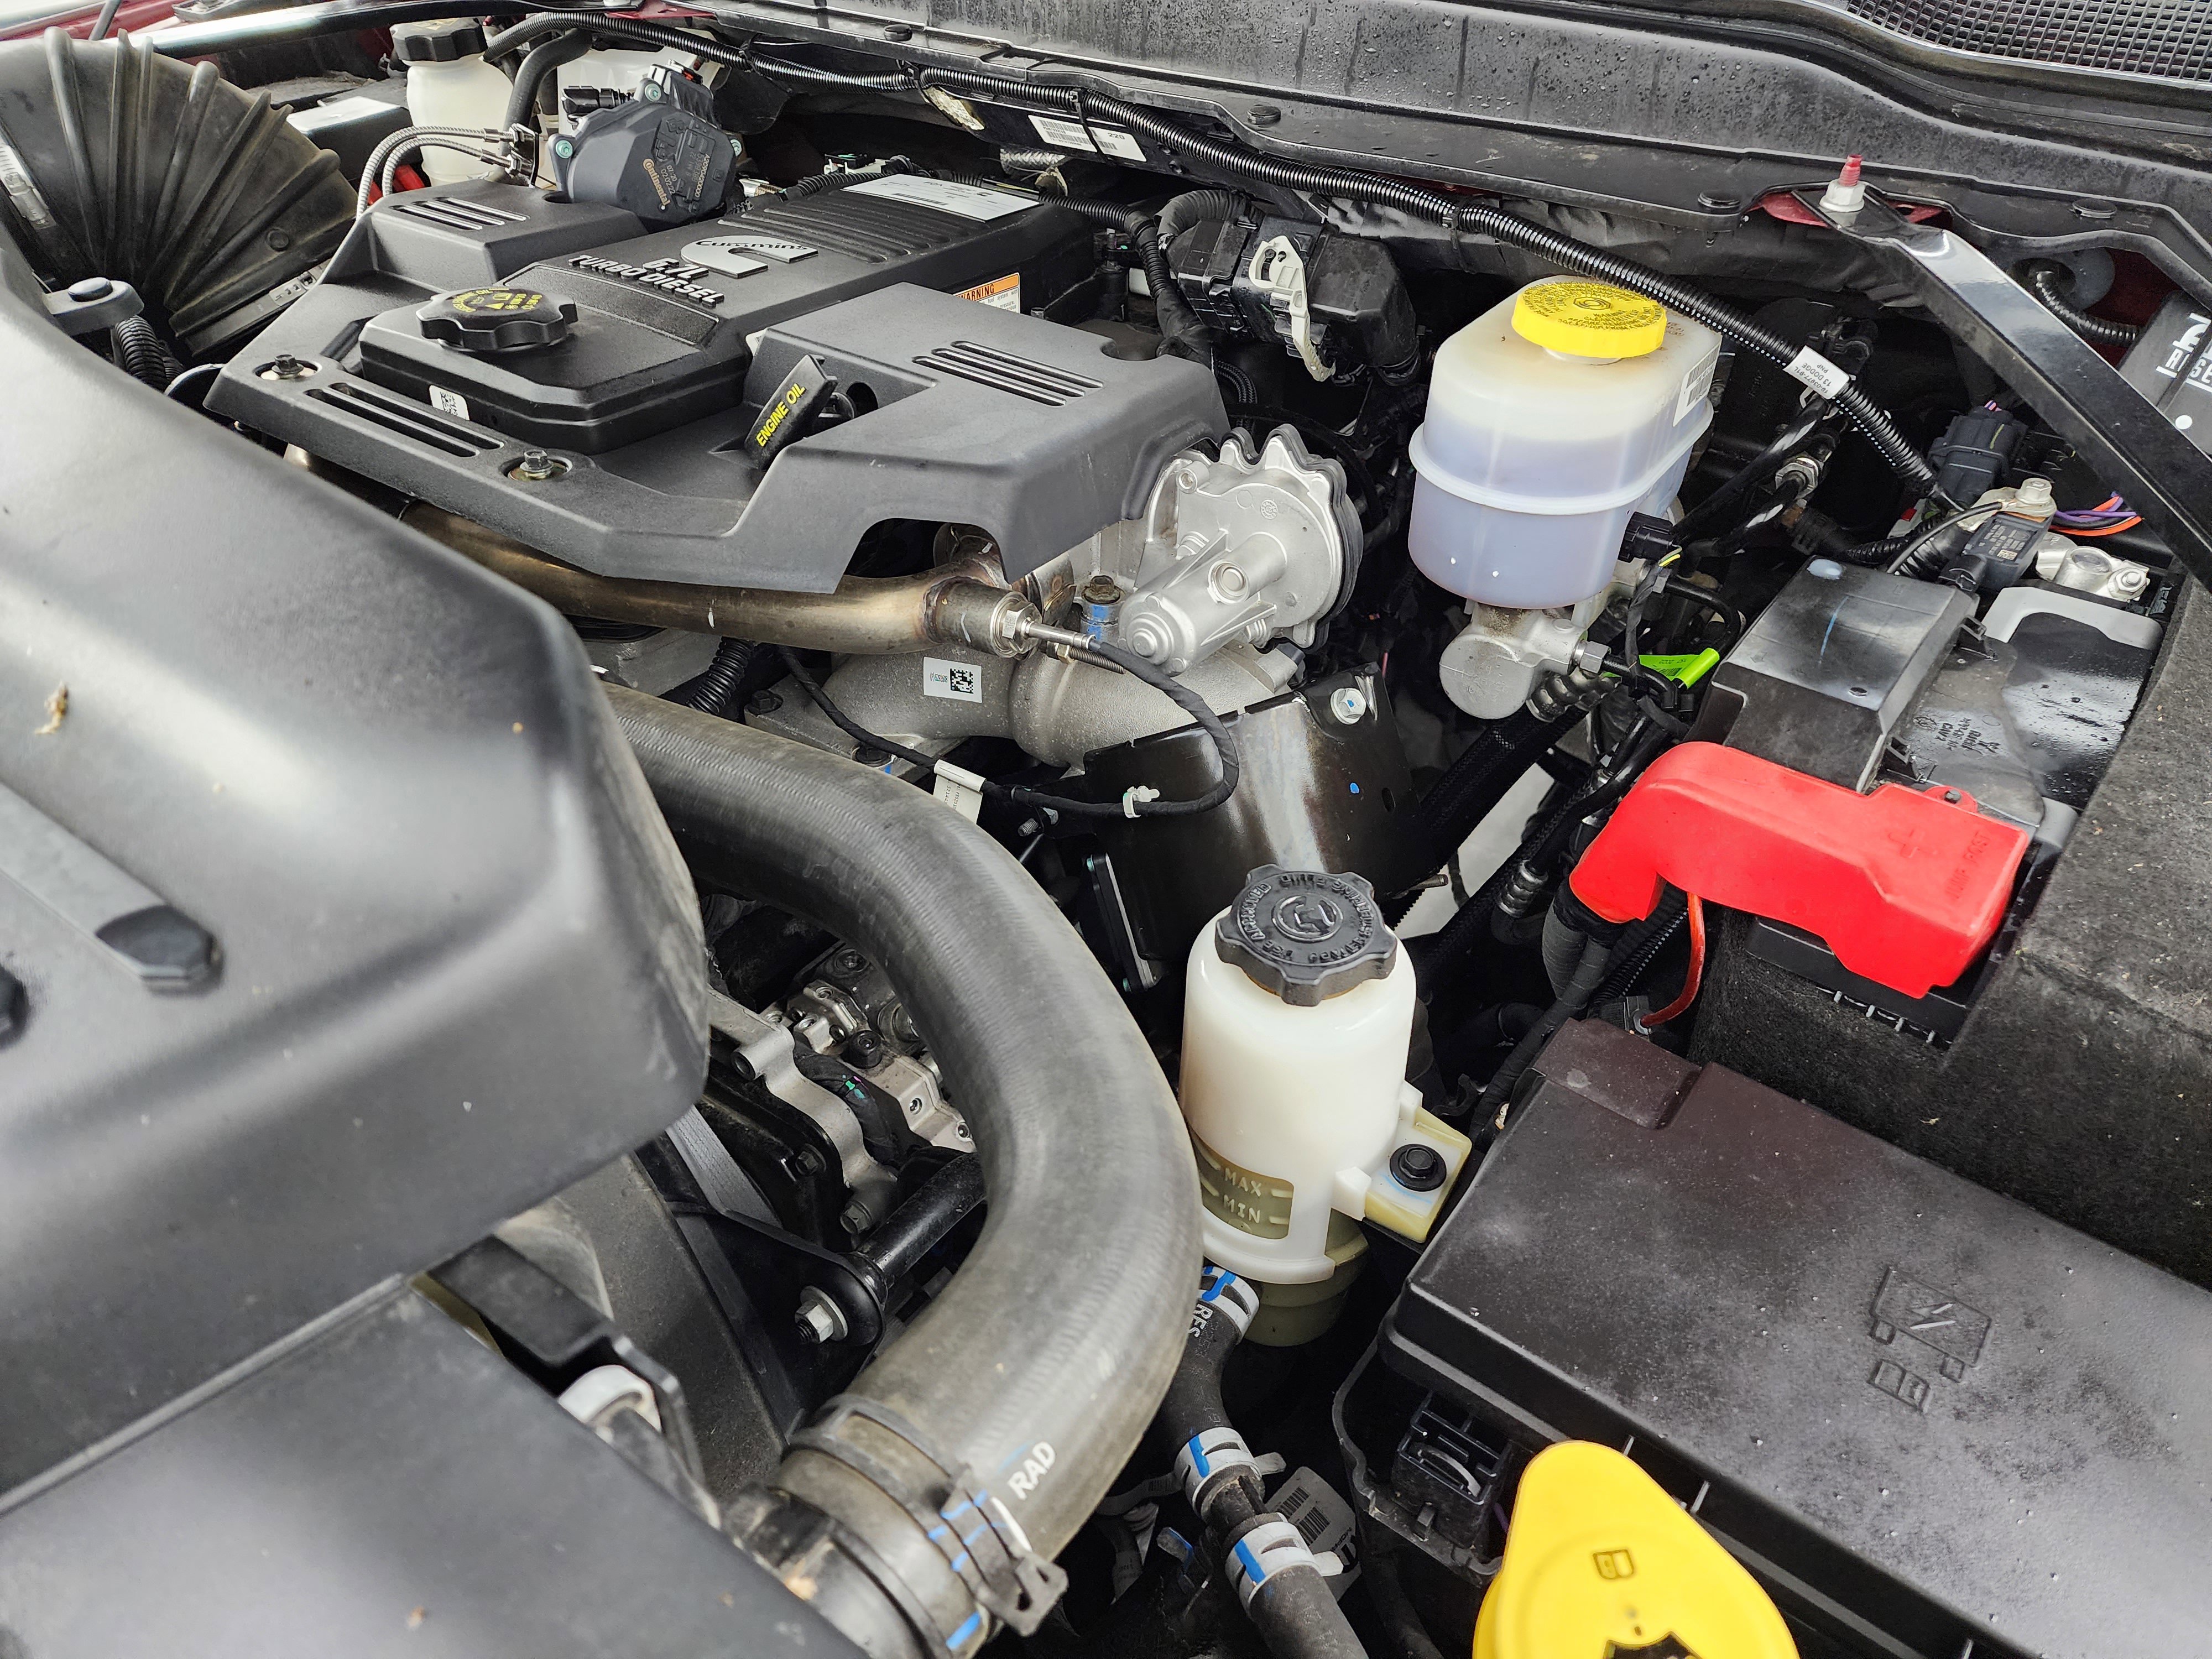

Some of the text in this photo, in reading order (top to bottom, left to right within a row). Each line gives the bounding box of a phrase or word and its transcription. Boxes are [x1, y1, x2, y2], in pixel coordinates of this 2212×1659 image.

[643, 158, 671, 206] Continental
[695, 239, 808, 251] Cummins
[568, 254, 648, 278] TURBO
[639, 273, 725, 308] DIESEL
[1802, 362, 1832, 387] 13 DODGE
[1817, 364, 1829, 374] PNP
[756, 383, 806, 447] ENGINE OIL
[1225, 1167, 1261, 1197] MAX
[1224, 1194, 1260, 1223] MIN
[1007, 1441, 1056, 1500] RAD
